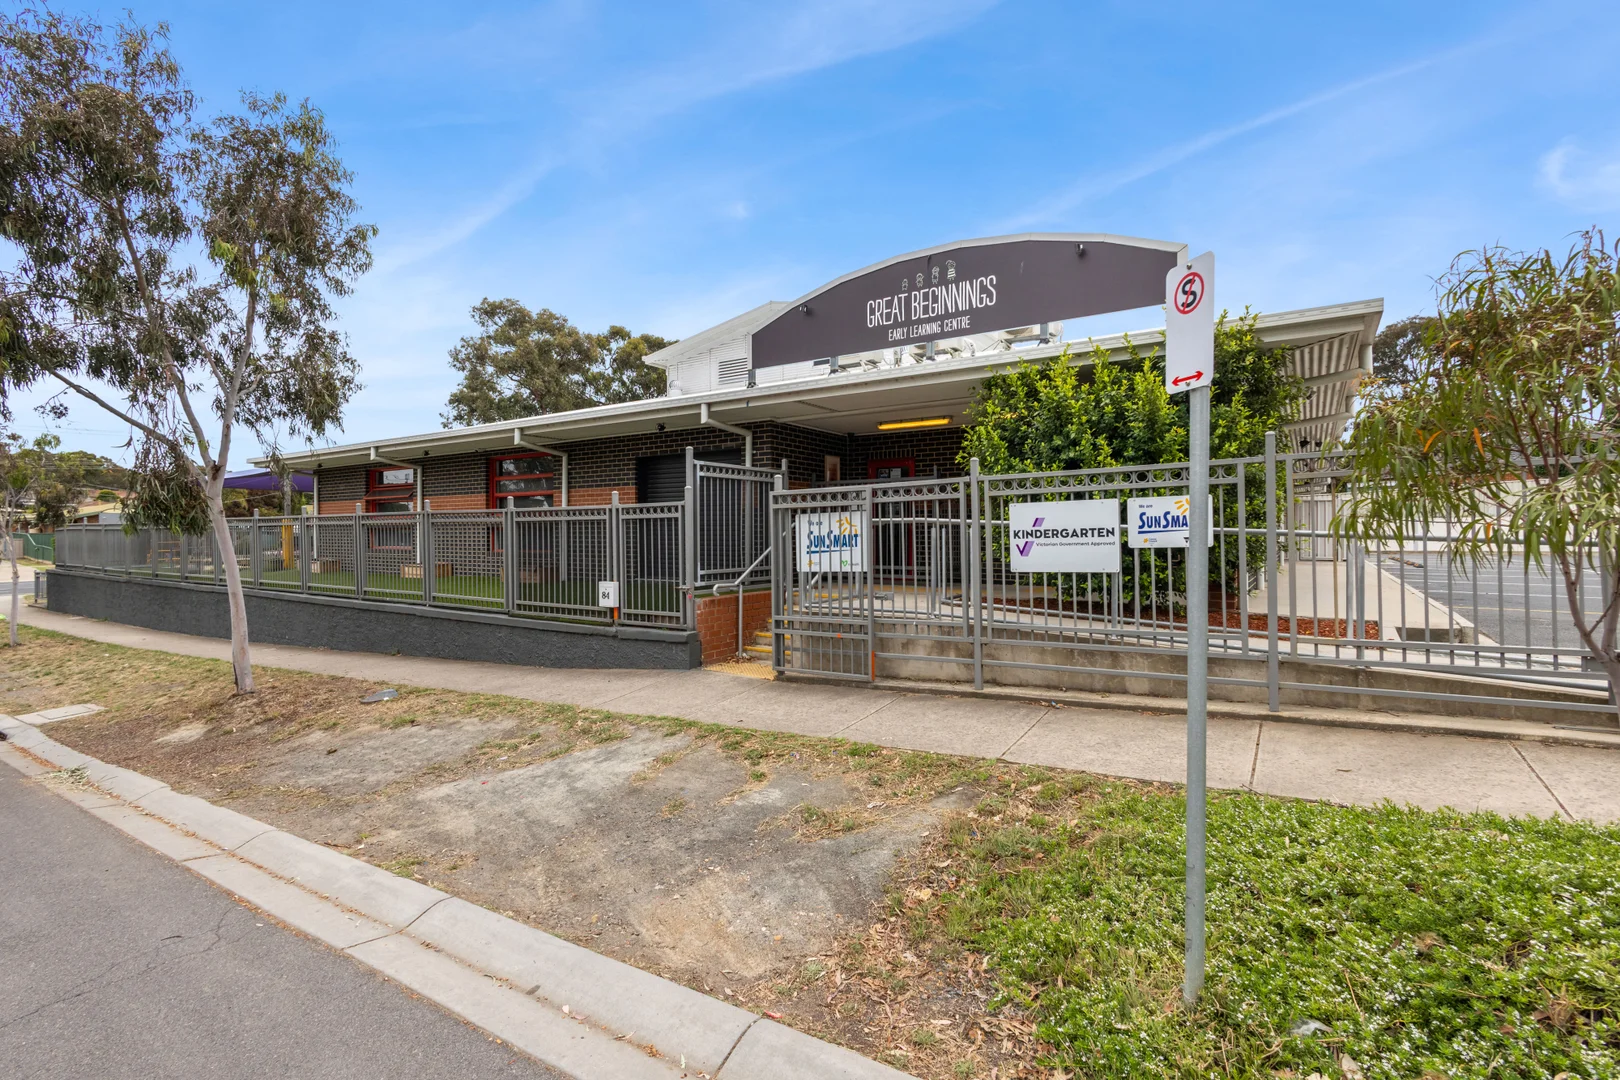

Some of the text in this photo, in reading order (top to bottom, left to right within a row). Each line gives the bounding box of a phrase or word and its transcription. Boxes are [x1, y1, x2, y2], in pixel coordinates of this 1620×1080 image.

[867, 275, 997, 327] GREAT BEGINNINGS
[888, 315, 971, 341] EARLY LEARNING CENTRE
[1138, 511, 1189, 529] SUNSMA
[1013, 527, 1115, 540] KINDERGARTEN
[602, 591, 610, 600] 84
